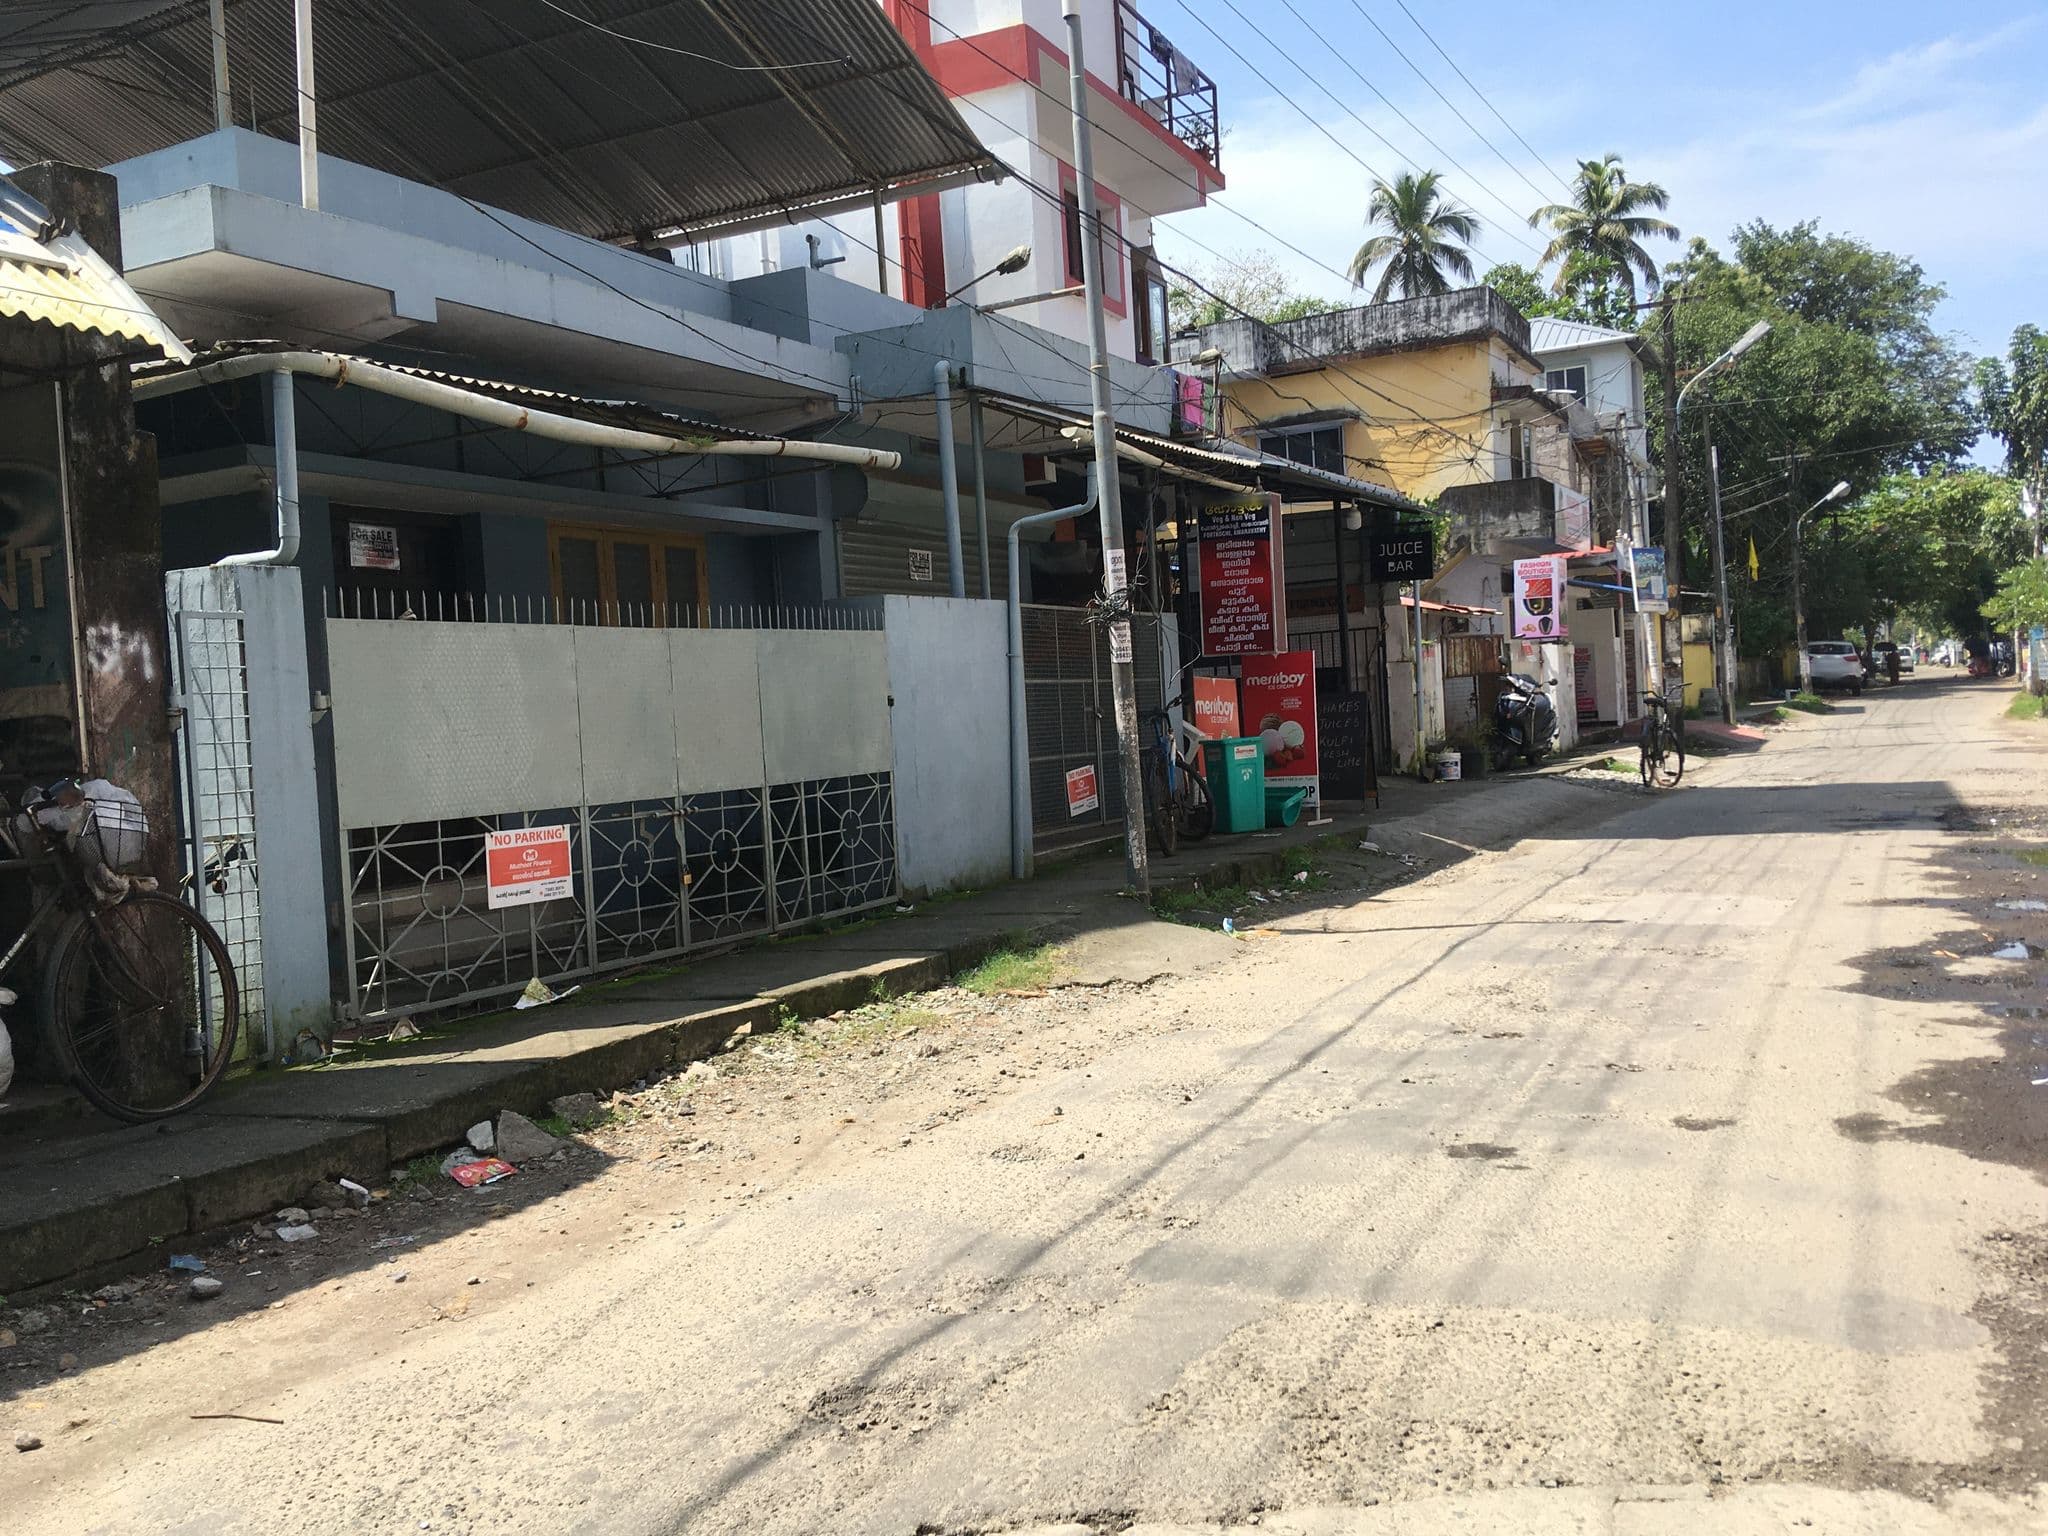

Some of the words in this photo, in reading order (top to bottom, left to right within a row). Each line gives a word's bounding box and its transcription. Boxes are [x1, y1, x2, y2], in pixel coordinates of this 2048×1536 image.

[370, 530, 393, 542] SALE
[1379, 541, 1423, 557] JUICE
[1387, 560, 1414, 573] BAR
[494, 834, 511, 846] NO
[515, 828, 562, 844] PARKING
